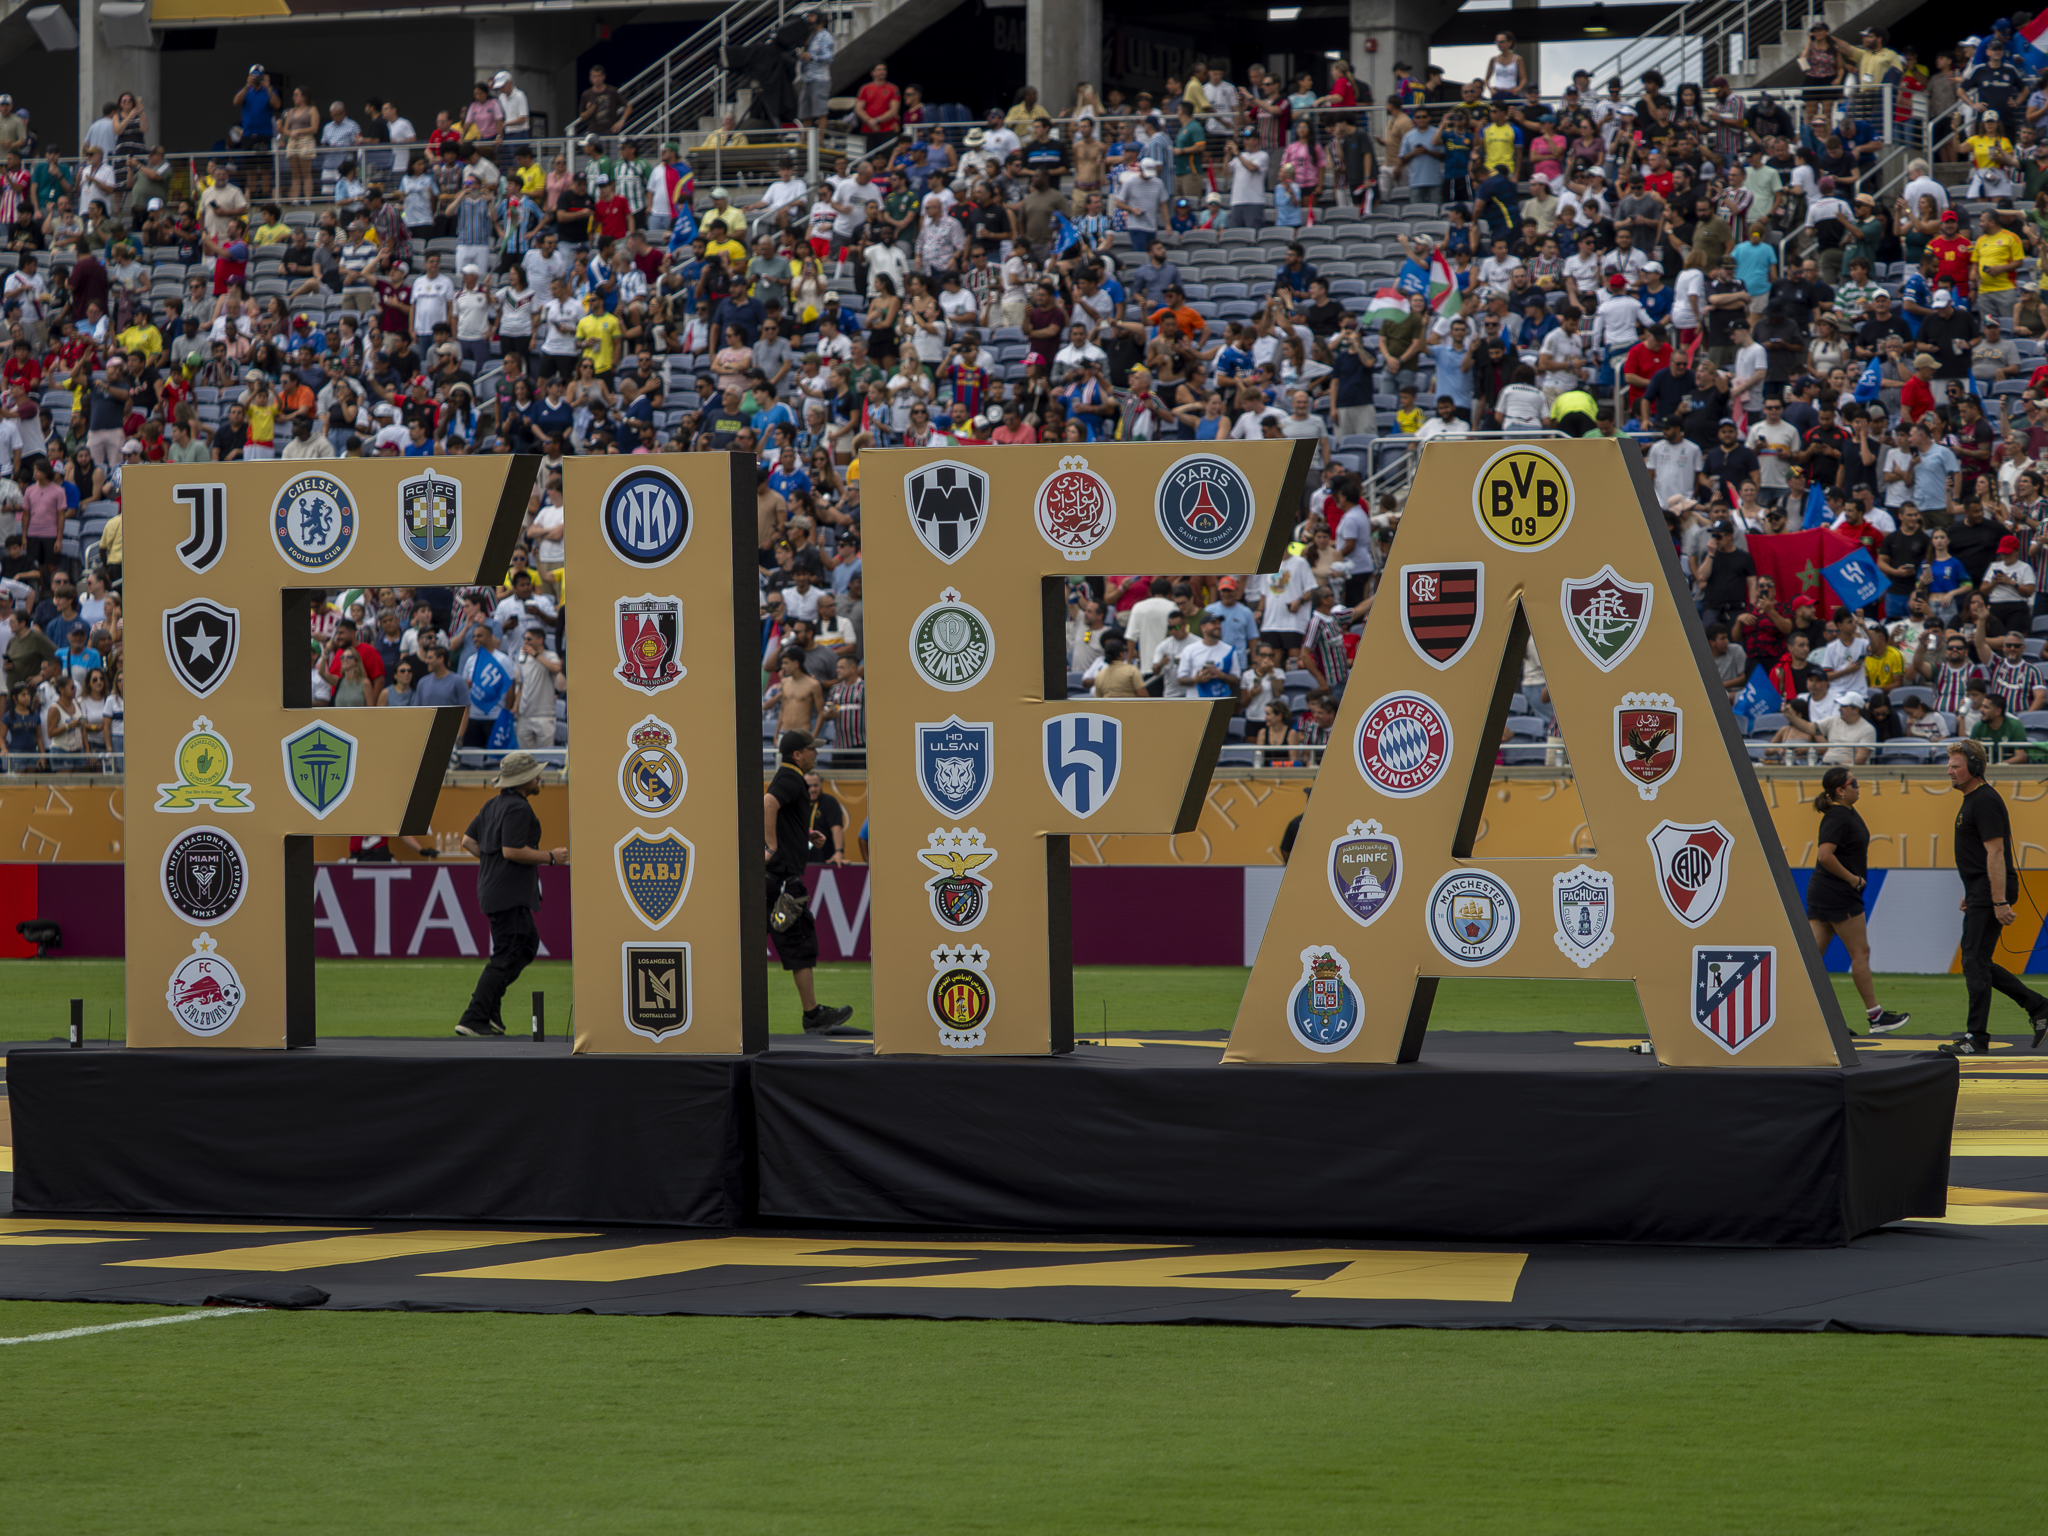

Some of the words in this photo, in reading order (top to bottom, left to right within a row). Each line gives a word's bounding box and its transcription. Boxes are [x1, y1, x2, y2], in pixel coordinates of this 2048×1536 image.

[1175, 466, 1230, 487] PARIS
[288, 479, 339, 499] CHELSEA
[406, 485, 424, 497] AC
[434, 485, 454, 496] FC
[1492, 461, 1558, 517] BVB
[1511, 516, 1536, 536] 09
[1178, 526, 1197, 542] SAINT
[1203, 526, 1233, 544] GERMAIN
[288, 547, 322, 564] FOOTBALL
[324, 545, 341, 560] CLUB
[919, 641, 985, 681] PALMEIRAS
[1366, 717, 1384, 739] FC
[1383, 702, 1441, 736] BAYERN
[190, 740, 218, 750] MAMELODI
[945, 733, 963, 741] HD
[930, 742, 979, 750] ULSAN
[189, 771, 219, 783] SUNDOWNS
[300, 773, 309, 781] 19
[331, 773, 340, 781] 74
[1367, 752, 1440, 786] MÜNCHEN
[169, 835, 228, 871] INTERNACIONAL
[228, 850, 237, 862] DE
[1342, 854, 1355, 863] AL
[1356, 853, 1374, 863] AIN
[1374, 852, 1388, 861] FC
[629, 863, 681, 880] CABJ
[169, 876, 179, 899] CLUB
[1439, 880, 1505, 907] MANCHESTER
[1563, 889, 1604, 901] PACHUCA
[192, 909, 217, 917] MMXX
[1569, 925, 1577, 935] DE
[1461, 945, 1485, 955] CITY
[199, 962, 211, 973] FC
[184, 1003, 227, 1026] SALZBURG
